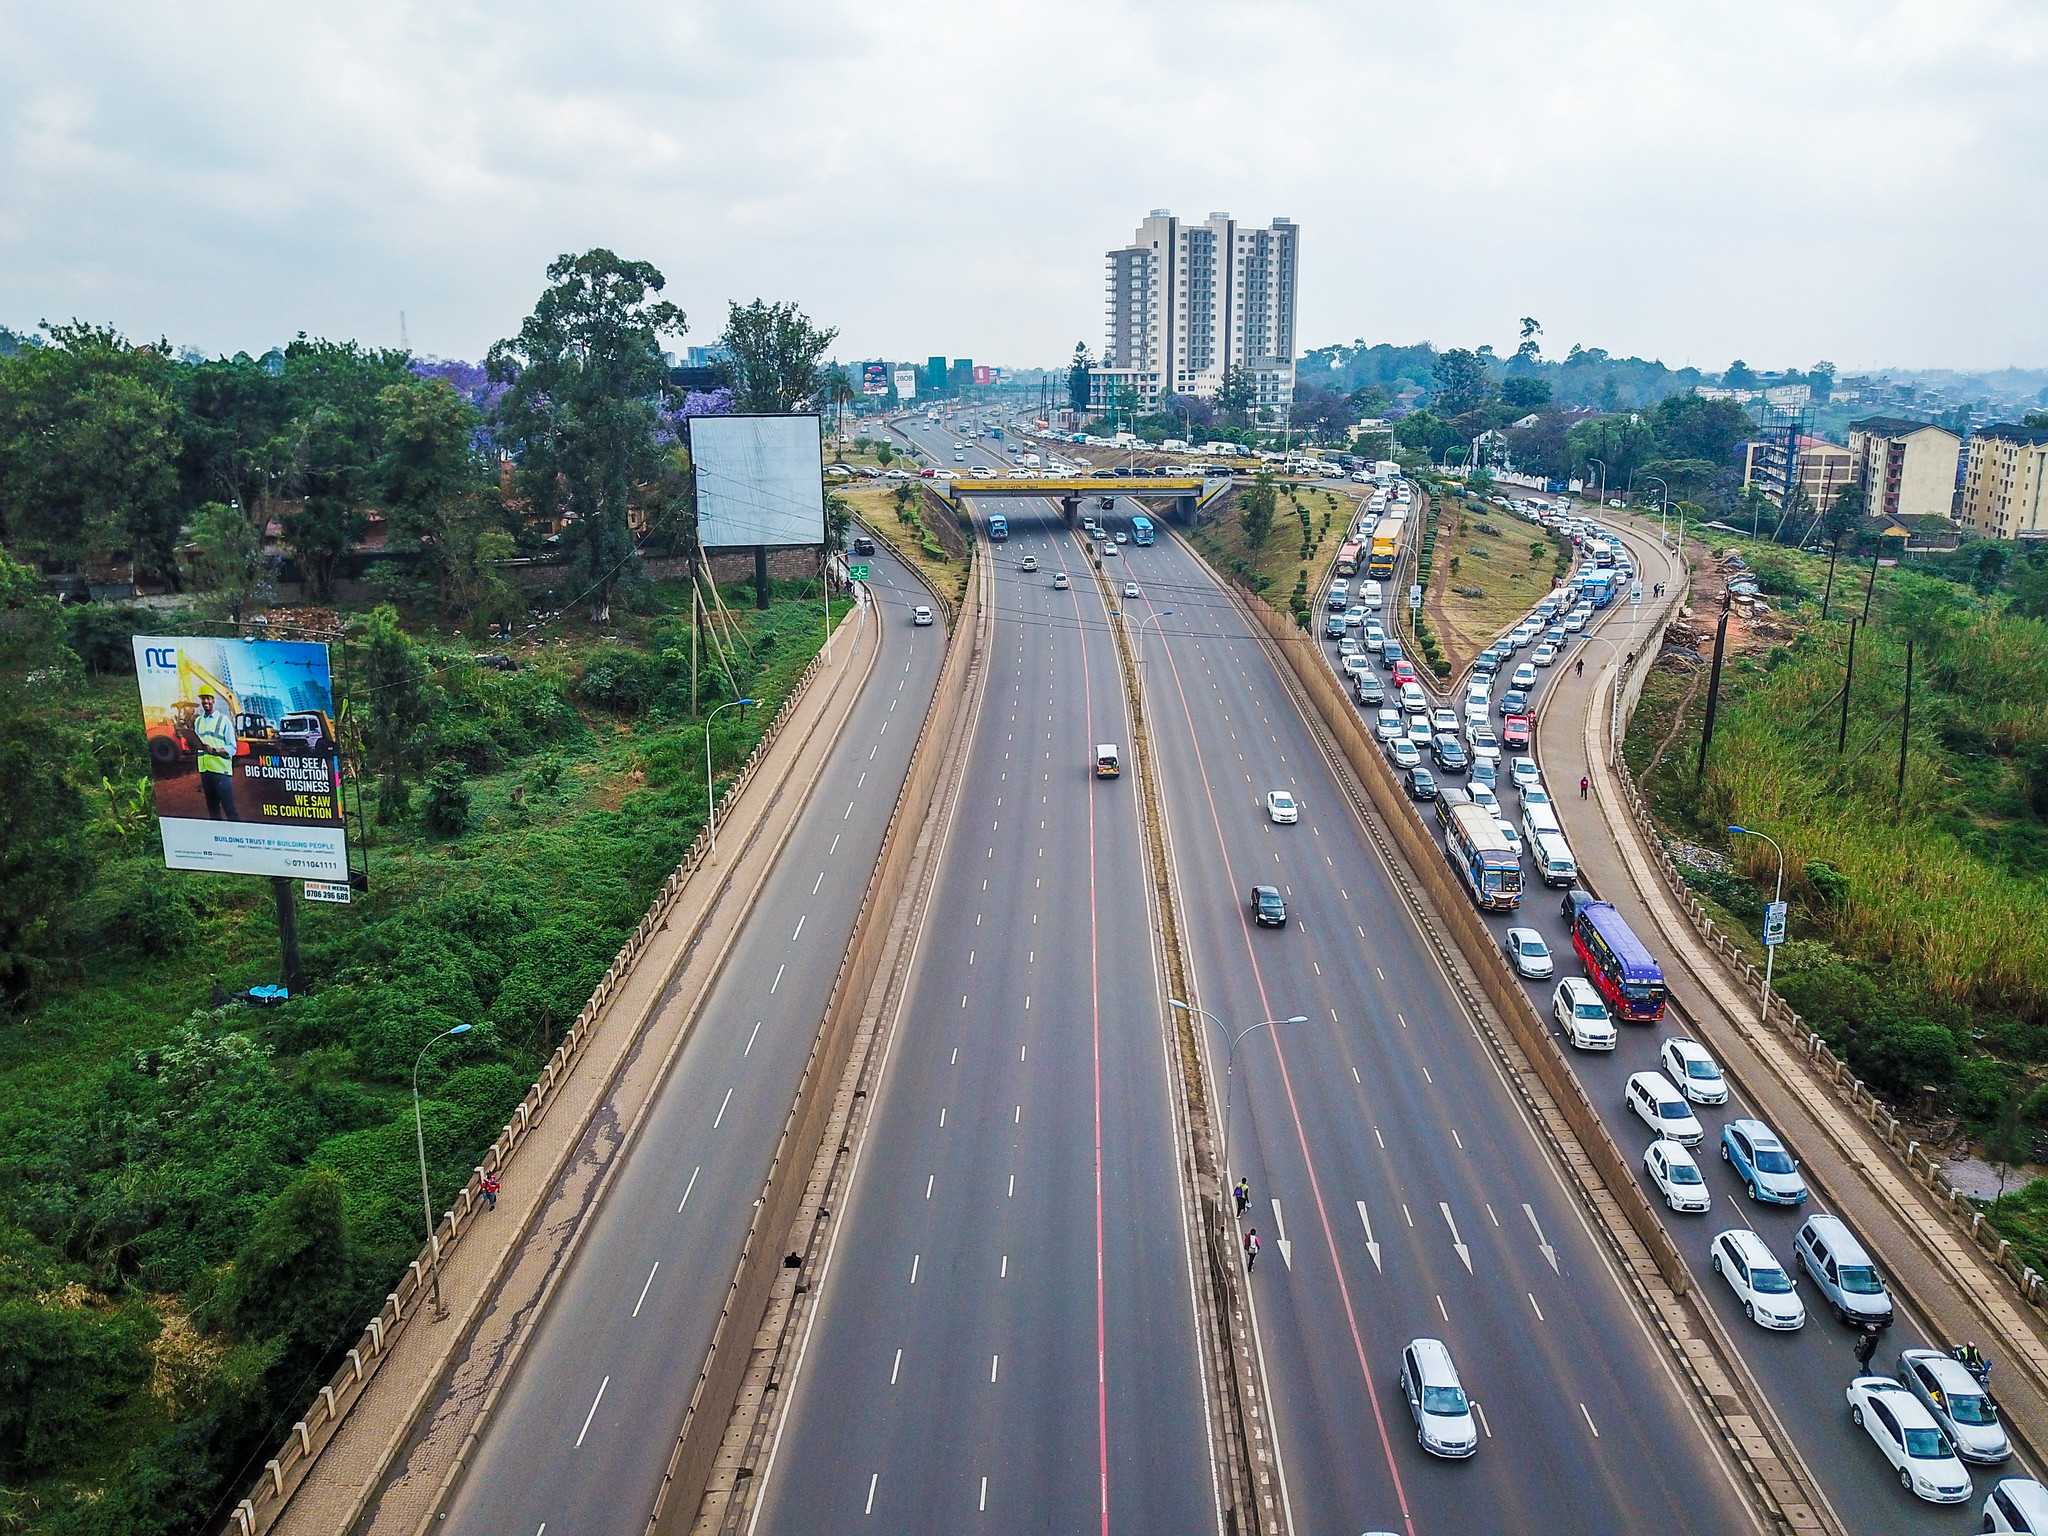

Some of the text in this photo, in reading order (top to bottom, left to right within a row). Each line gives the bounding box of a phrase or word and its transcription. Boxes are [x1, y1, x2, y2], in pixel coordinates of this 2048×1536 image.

[259, 755, 328, 770] NOW YOU SEE A
[245, 765, 329, 780] BIG CONSTRUCTION
[285, 780, 330, 793] BUSINESS
[294, 795, 331, 807] WE SAW
[263, 804, 332, 819] HIS CONVICTION
[214, 836, 244, 844] BUILDING
[309, 842, 334, 850] PEOPLE
[292, 859, 337, 869] 0711041111
